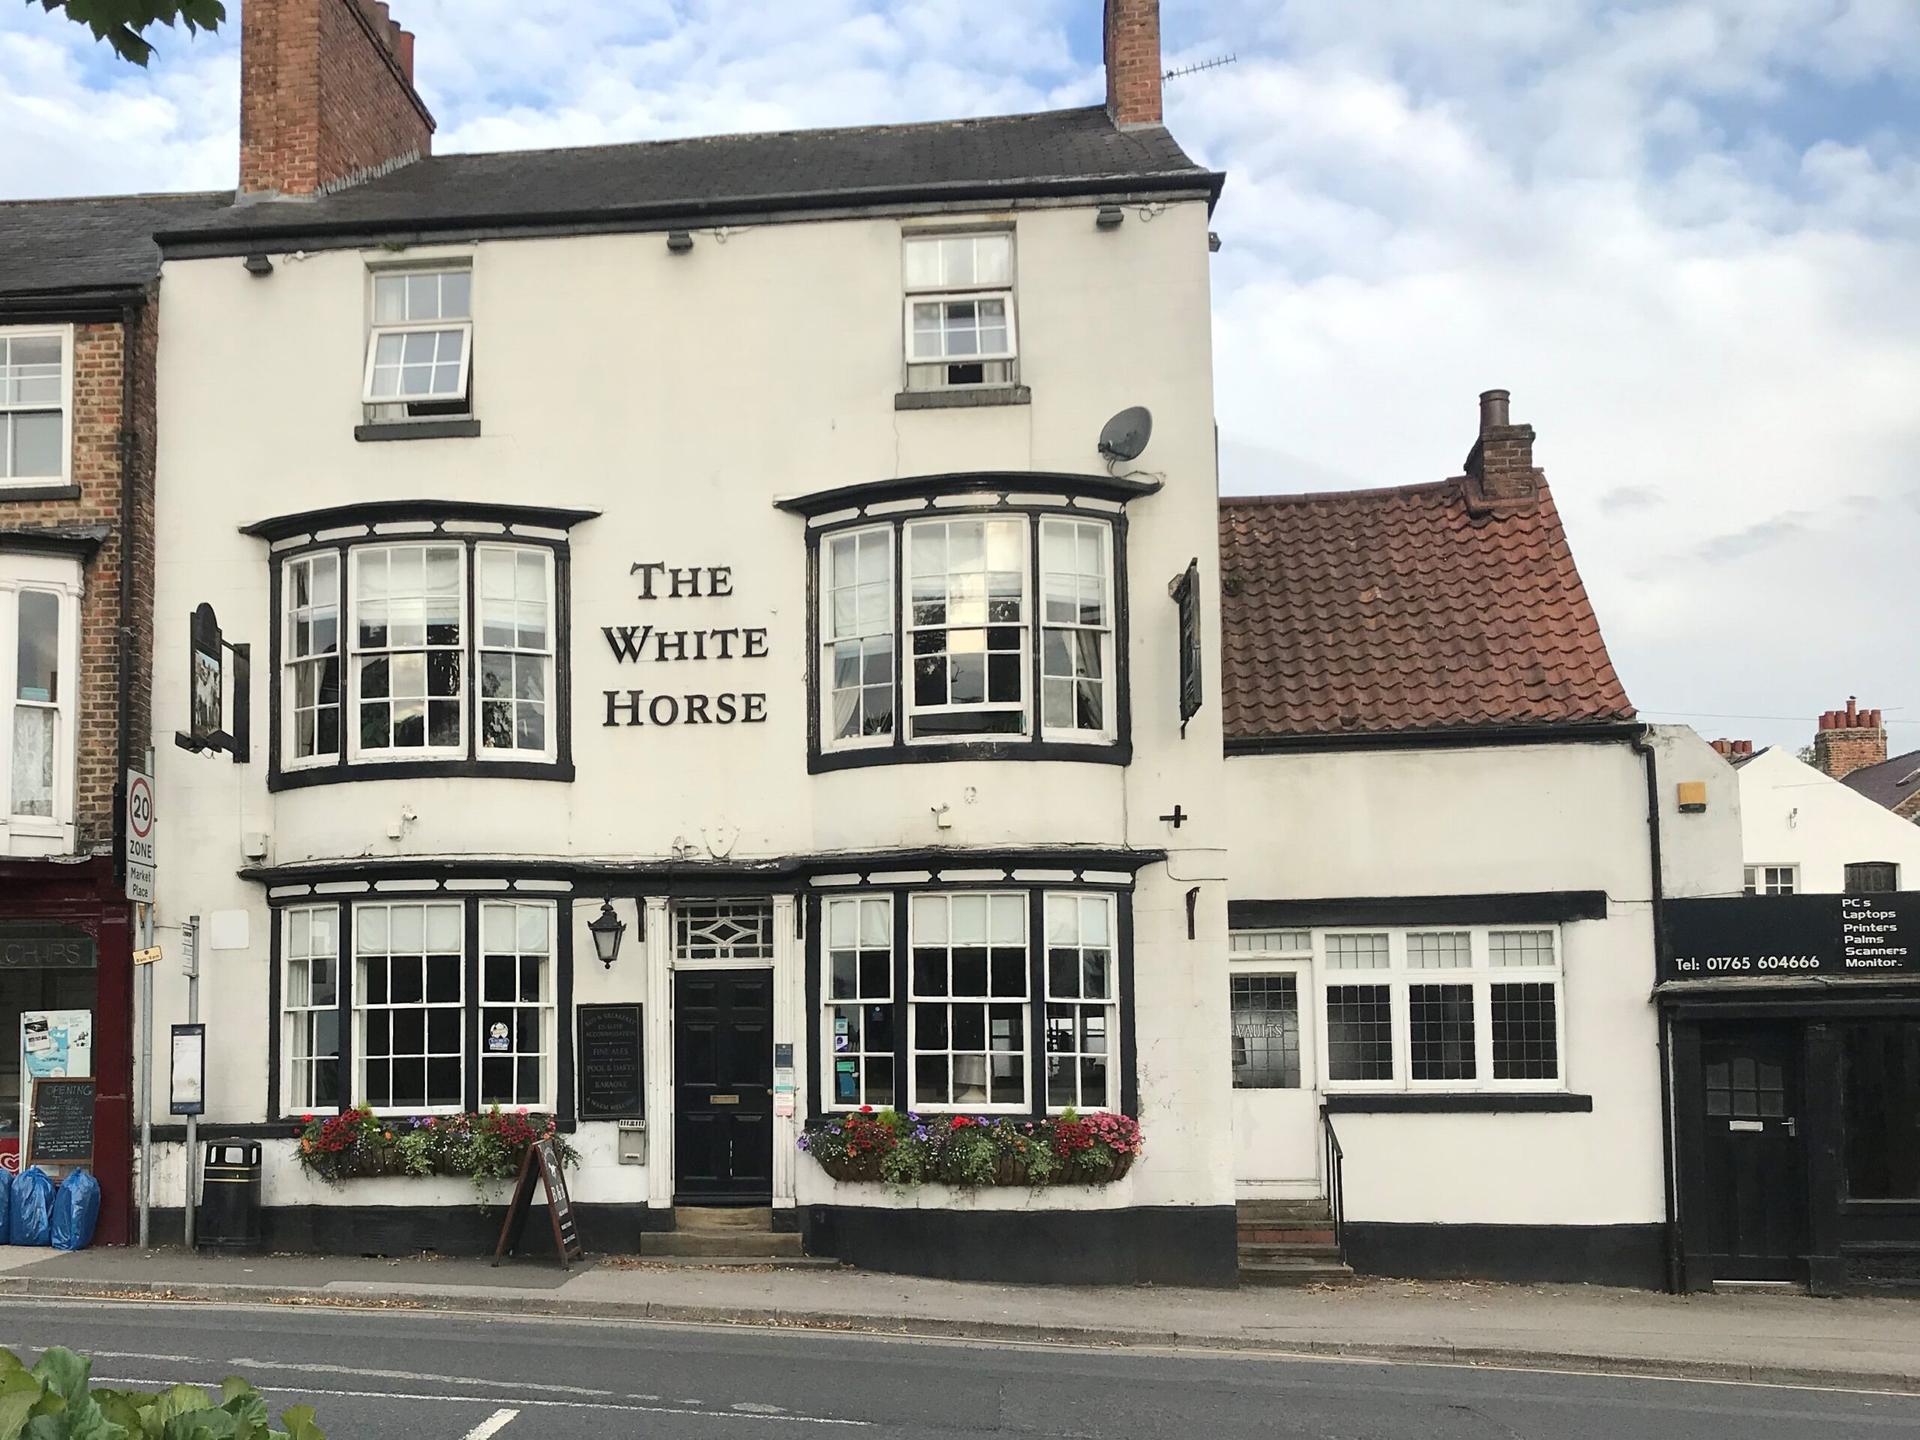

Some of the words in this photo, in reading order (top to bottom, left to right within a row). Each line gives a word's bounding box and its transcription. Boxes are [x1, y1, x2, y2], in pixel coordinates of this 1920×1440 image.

[630, 561, 733, 600] THE
[600, 625, 769, 664] WHITE
[602, 689, 768, 726] HORSE
[133, 794, 150, 821] 20
[130, 840, 152, 858] ZONE
[130, 867, 151, 883] Market
[132, 883, 149, 898] Place
[1842, 910, 1897, 920] Laptops
[1843, 923, 1898, 932] Printers
[1844, 935, 1884, 944] Palms
[1845, 946, 1908, 956] Scanners
[1675, 957, 1700, 970] Tel:
[1706, 957, 1751, 970] 01765
[1757, 955, 1820, 969] 604666
